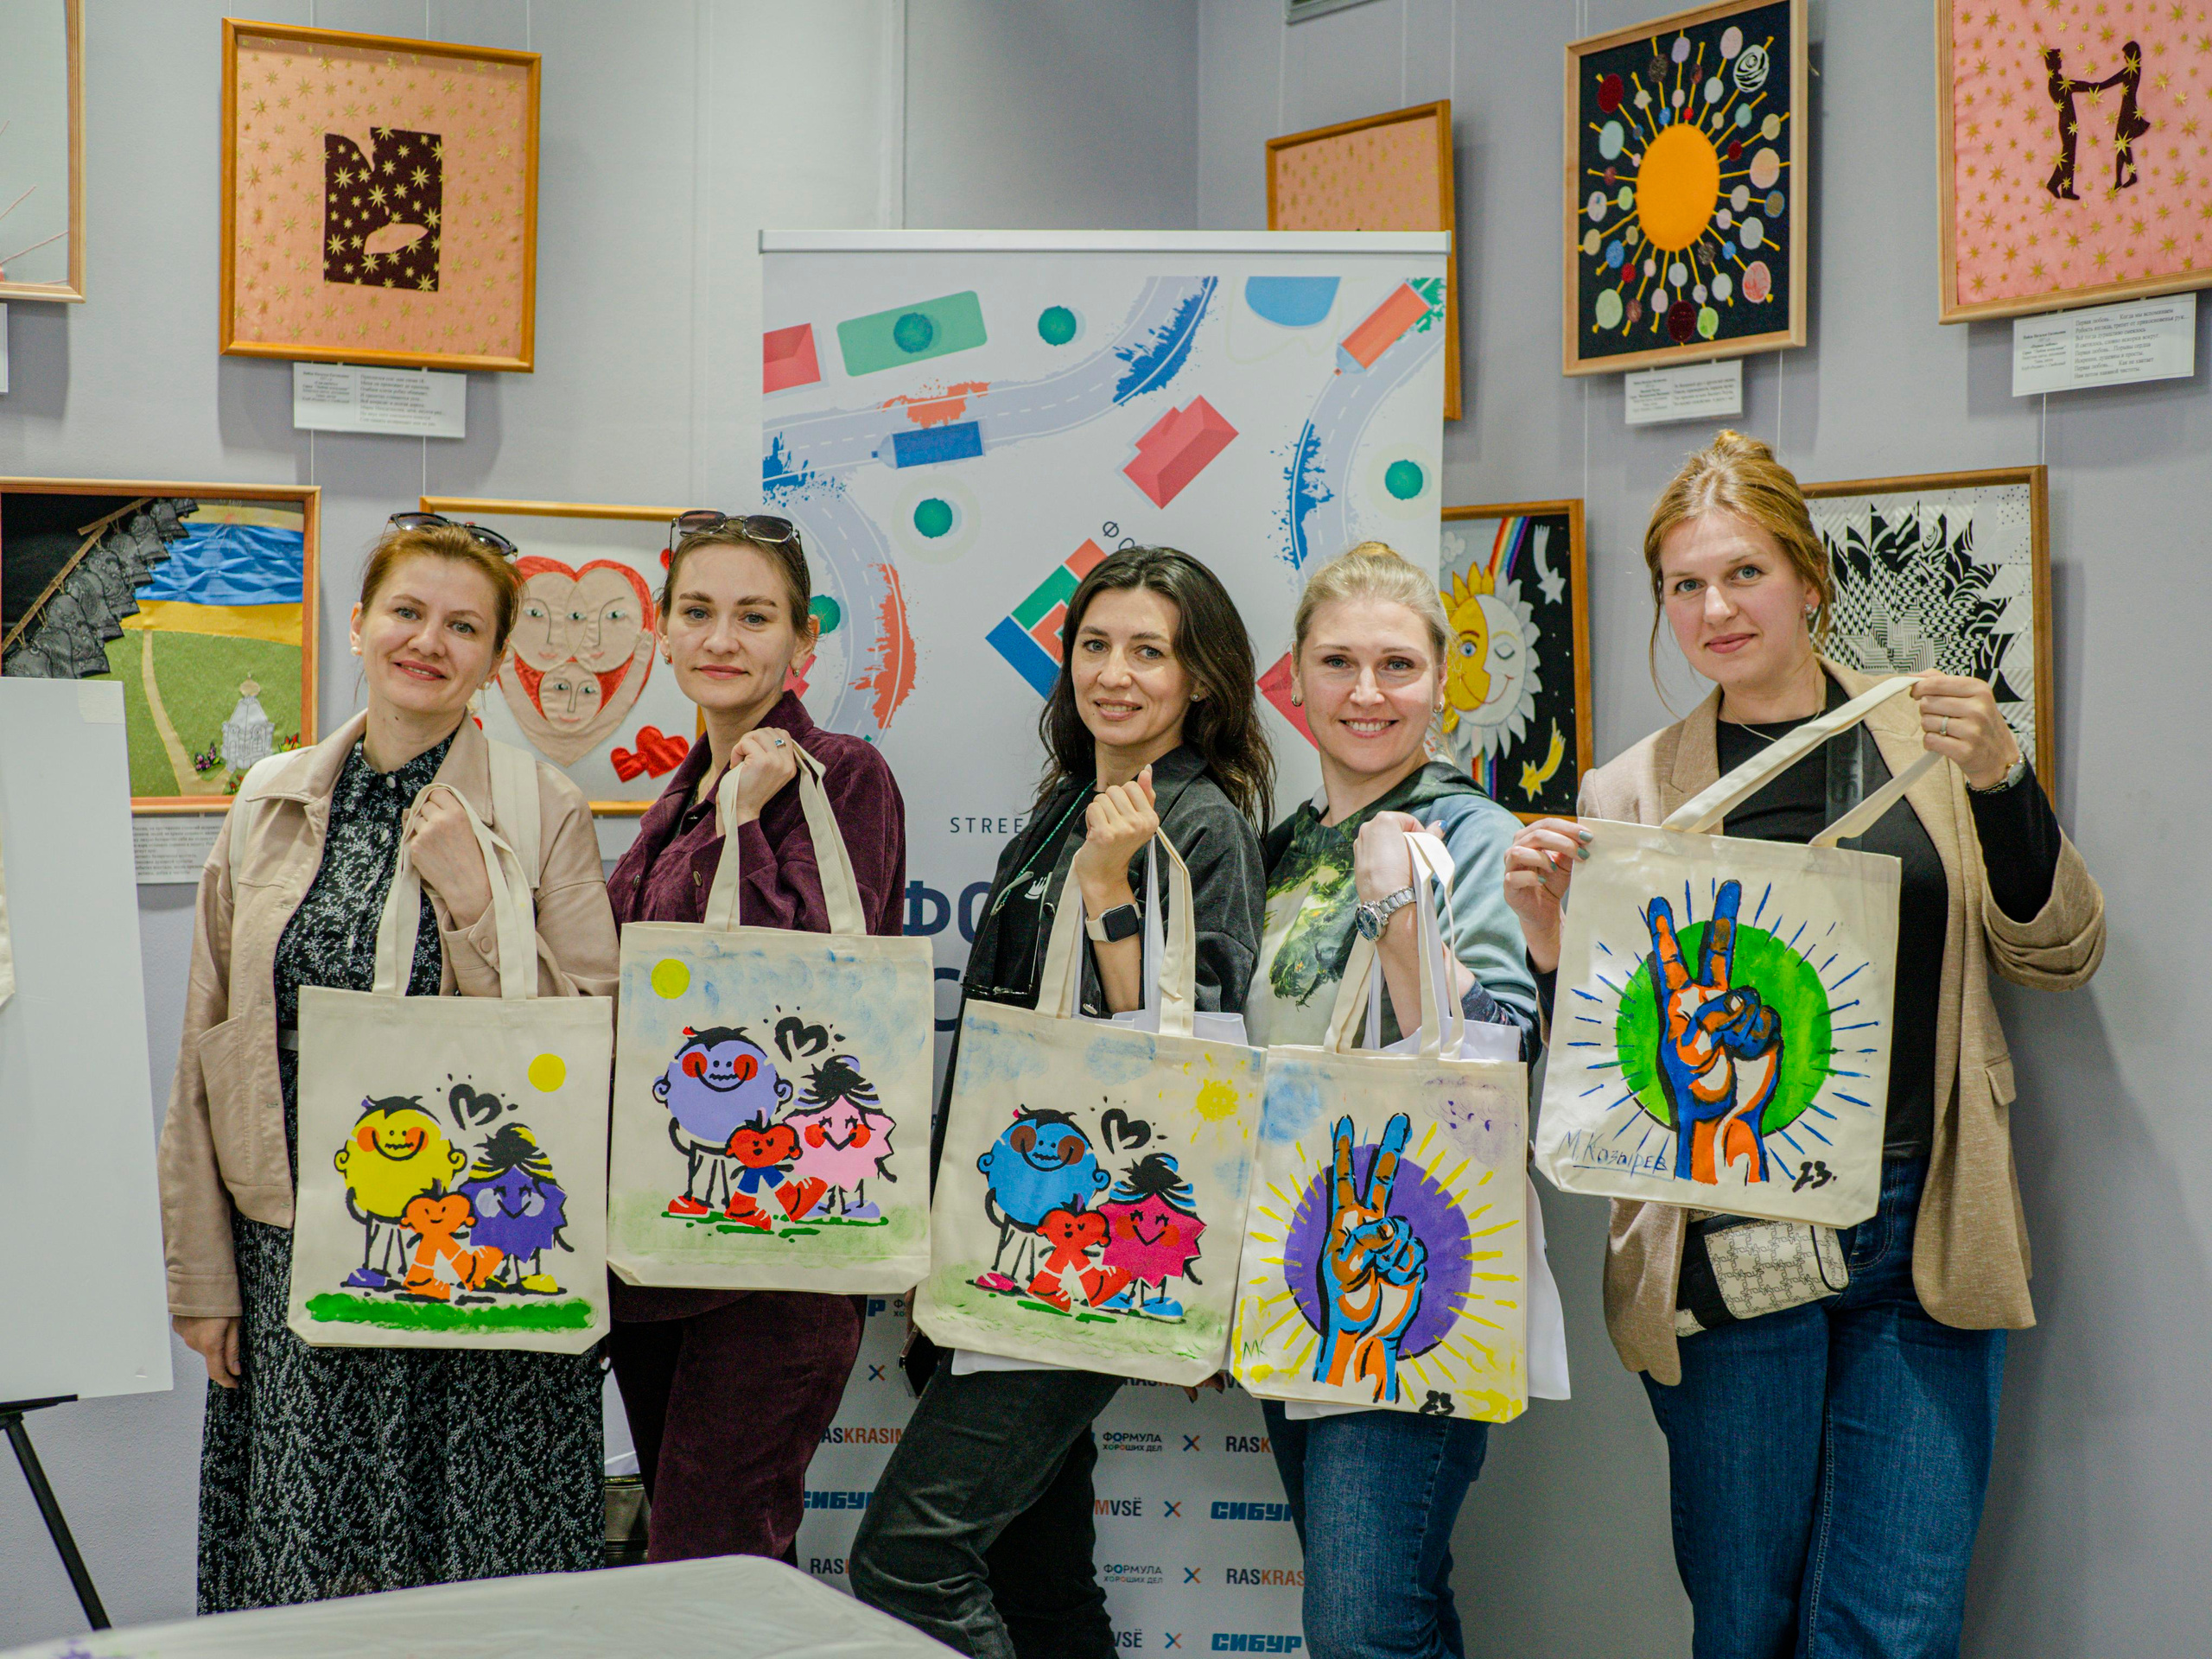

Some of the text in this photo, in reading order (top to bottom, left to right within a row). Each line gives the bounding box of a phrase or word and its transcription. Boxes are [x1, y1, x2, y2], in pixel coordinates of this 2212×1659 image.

[1102, 1431, 1163, 1443] ФОРМУЛА
[1102, 1443, 1163, 1453] ХОРОШИХ ДЕЛ
[1103, 1563, 1163, 1575] ФОРМУЛА
[1103, 1575, 1145, 1584] ХОРОШИХ
[1211, 1632, 1303, 1654] СИБУР
